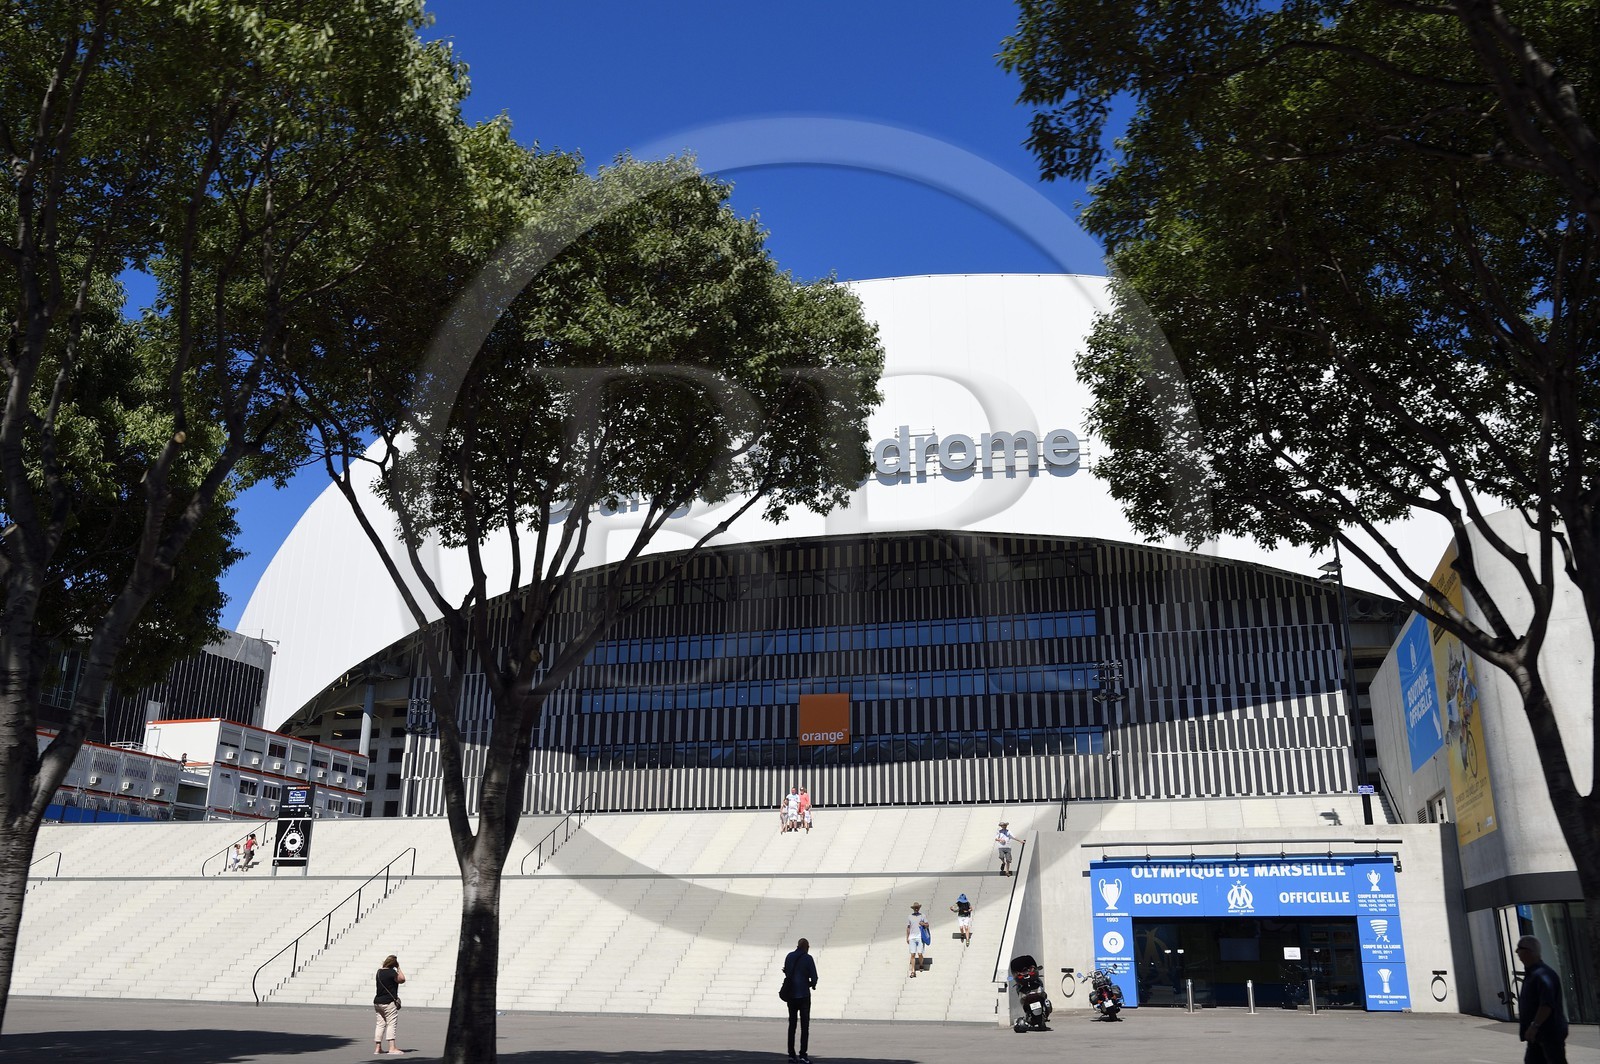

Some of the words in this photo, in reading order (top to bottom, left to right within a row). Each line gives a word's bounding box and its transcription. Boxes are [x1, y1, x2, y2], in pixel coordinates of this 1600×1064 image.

[873, 425, 1081, 475] drome
[1407, 666, 1429, 708] BOUTIQUE
[1409, 687, 1433, 729] OFFICIELLE
[801, 731, 844, 743] orange
[1131, 864, 1225, 880] OLYMPIQUE
[1228, 863, 1250, 878] DE
[1253, 862, 1346, 877] MARSEILLE
[1133, 892, 1199, 906] BOUTIQUE
[1278, 891, 1351, 904] OFFICIELLE
